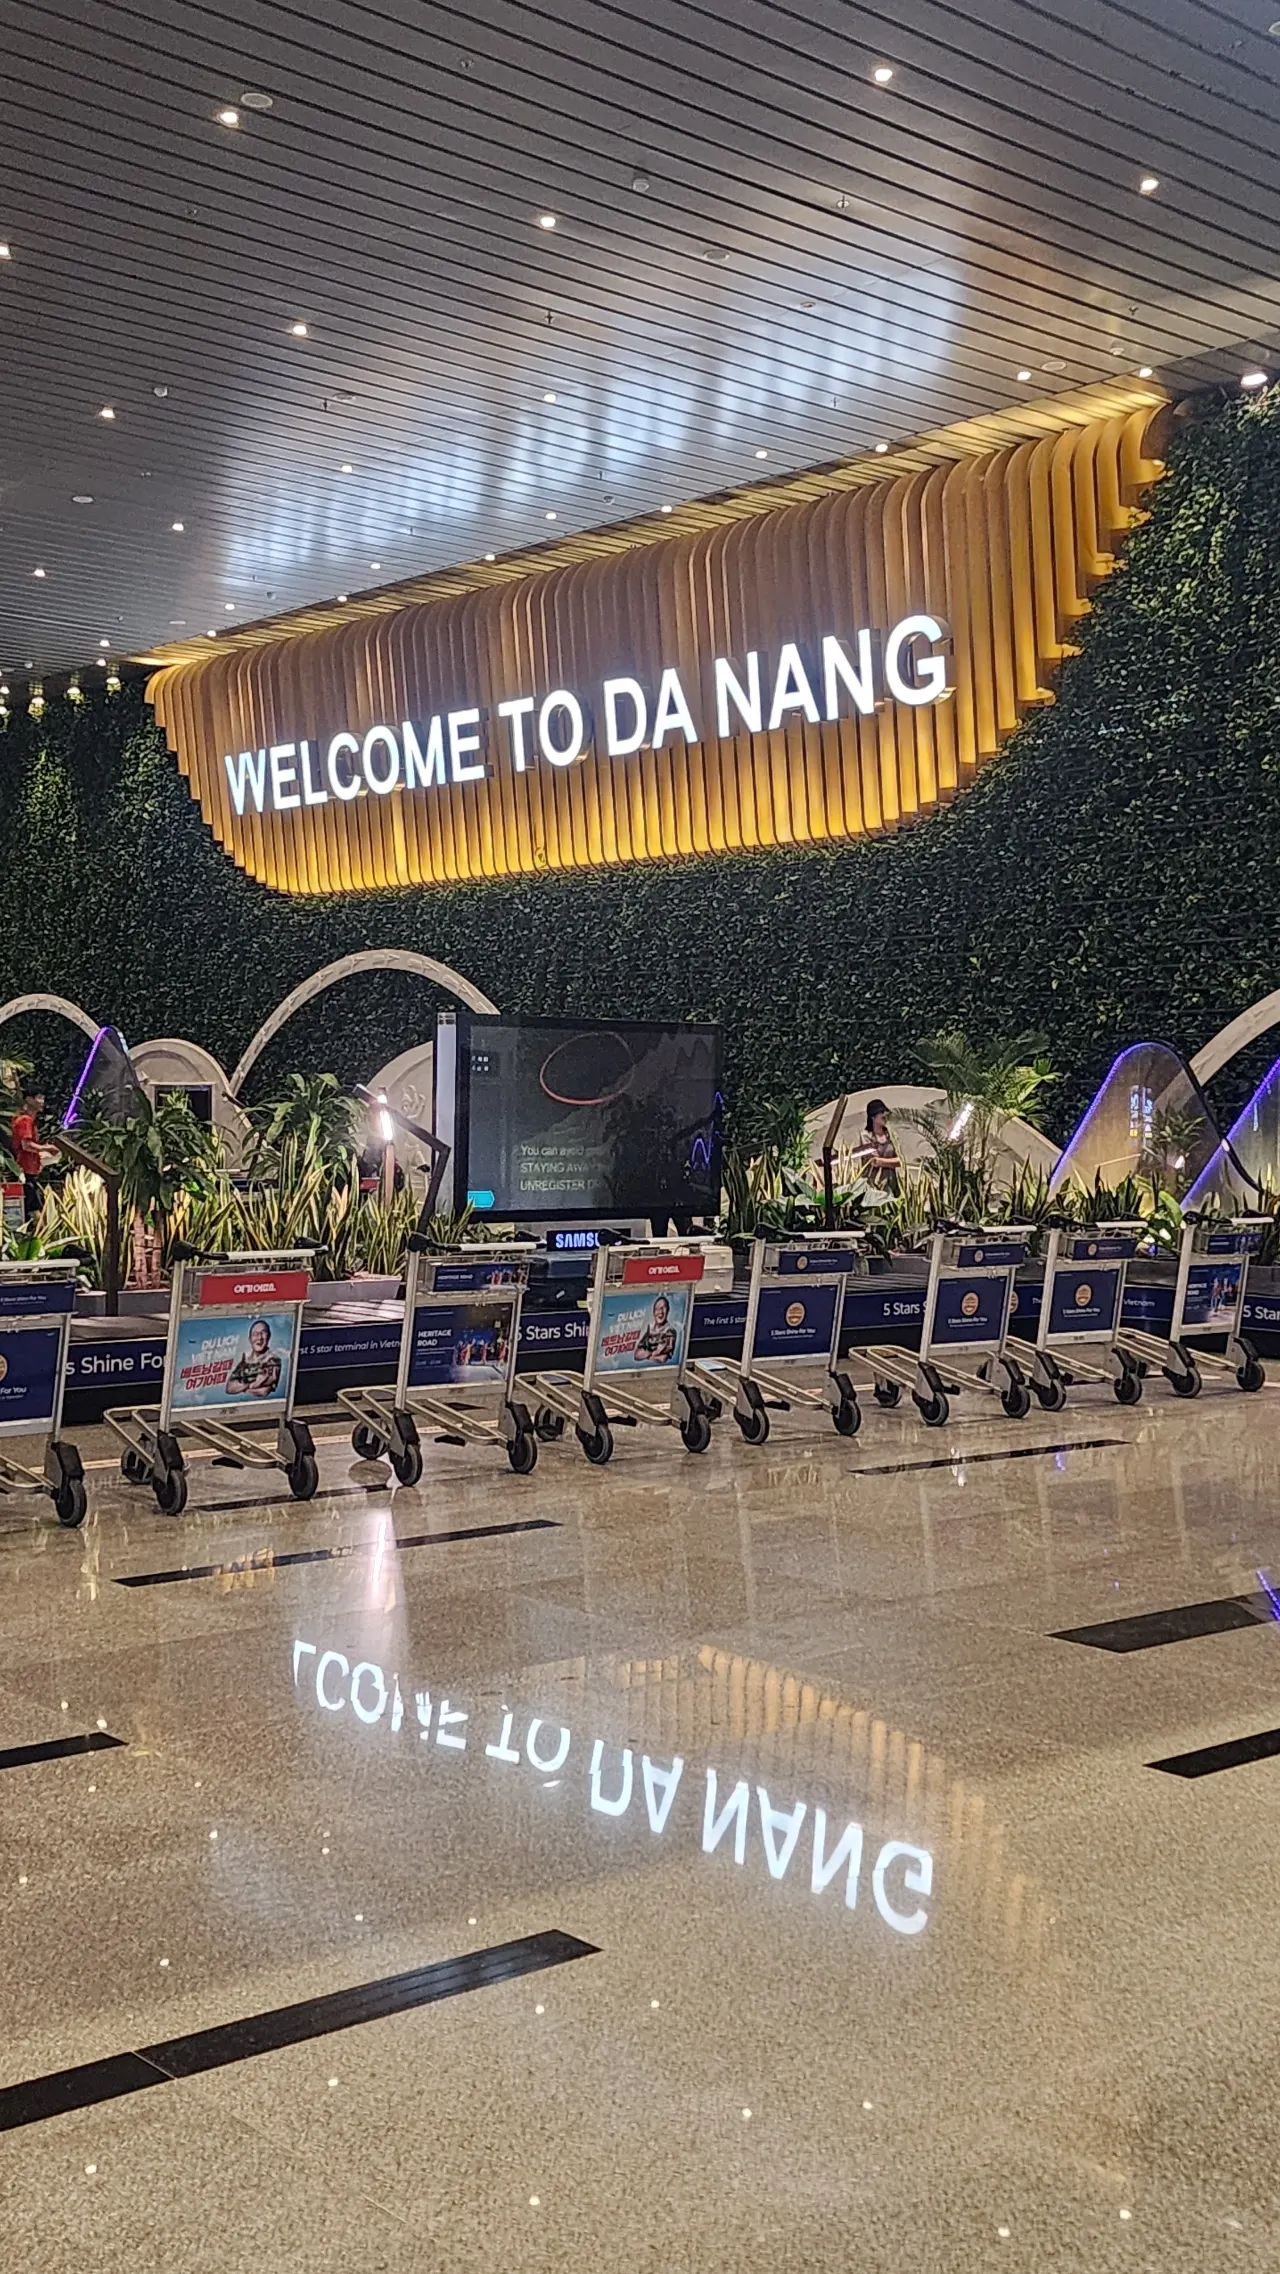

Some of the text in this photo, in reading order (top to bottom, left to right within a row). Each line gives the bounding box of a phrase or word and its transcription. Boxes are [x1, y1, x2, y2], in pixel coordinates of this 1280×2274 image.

[225, 614, 948, 815] WELCOME TO DA NANG
[520, 1145, 540, 1156] You
[541, 1147, 558, 1156] can
[520, 1162, 565, 1173] STAYING
[520, 1179, 585, 1191] UNREGISTER
[555, 1231, 601, 1249] SAMSU
[883, 1302, 891, 1316] 5
[893, 1301, 921, 1316] Stars
[1124, 1299, 1155, 1307] Vietnam
[1243, 1304, 1280, 1321] 5 Star
[526, 1325, 561, 1341] Stars
[564, 1321, 589, 1339] Shi
[310, 1344, 316, 1355] 5
[316, 1345, 333, 1355] star
[334, 1339, 370, 1353] terminal
[370, 1339, 378, 1350] in
[380, 1338, 401, 1349] Vietn
[416, 1338, 438, 1347] ROAD
[80, 1353, 135, 1374] Shine
